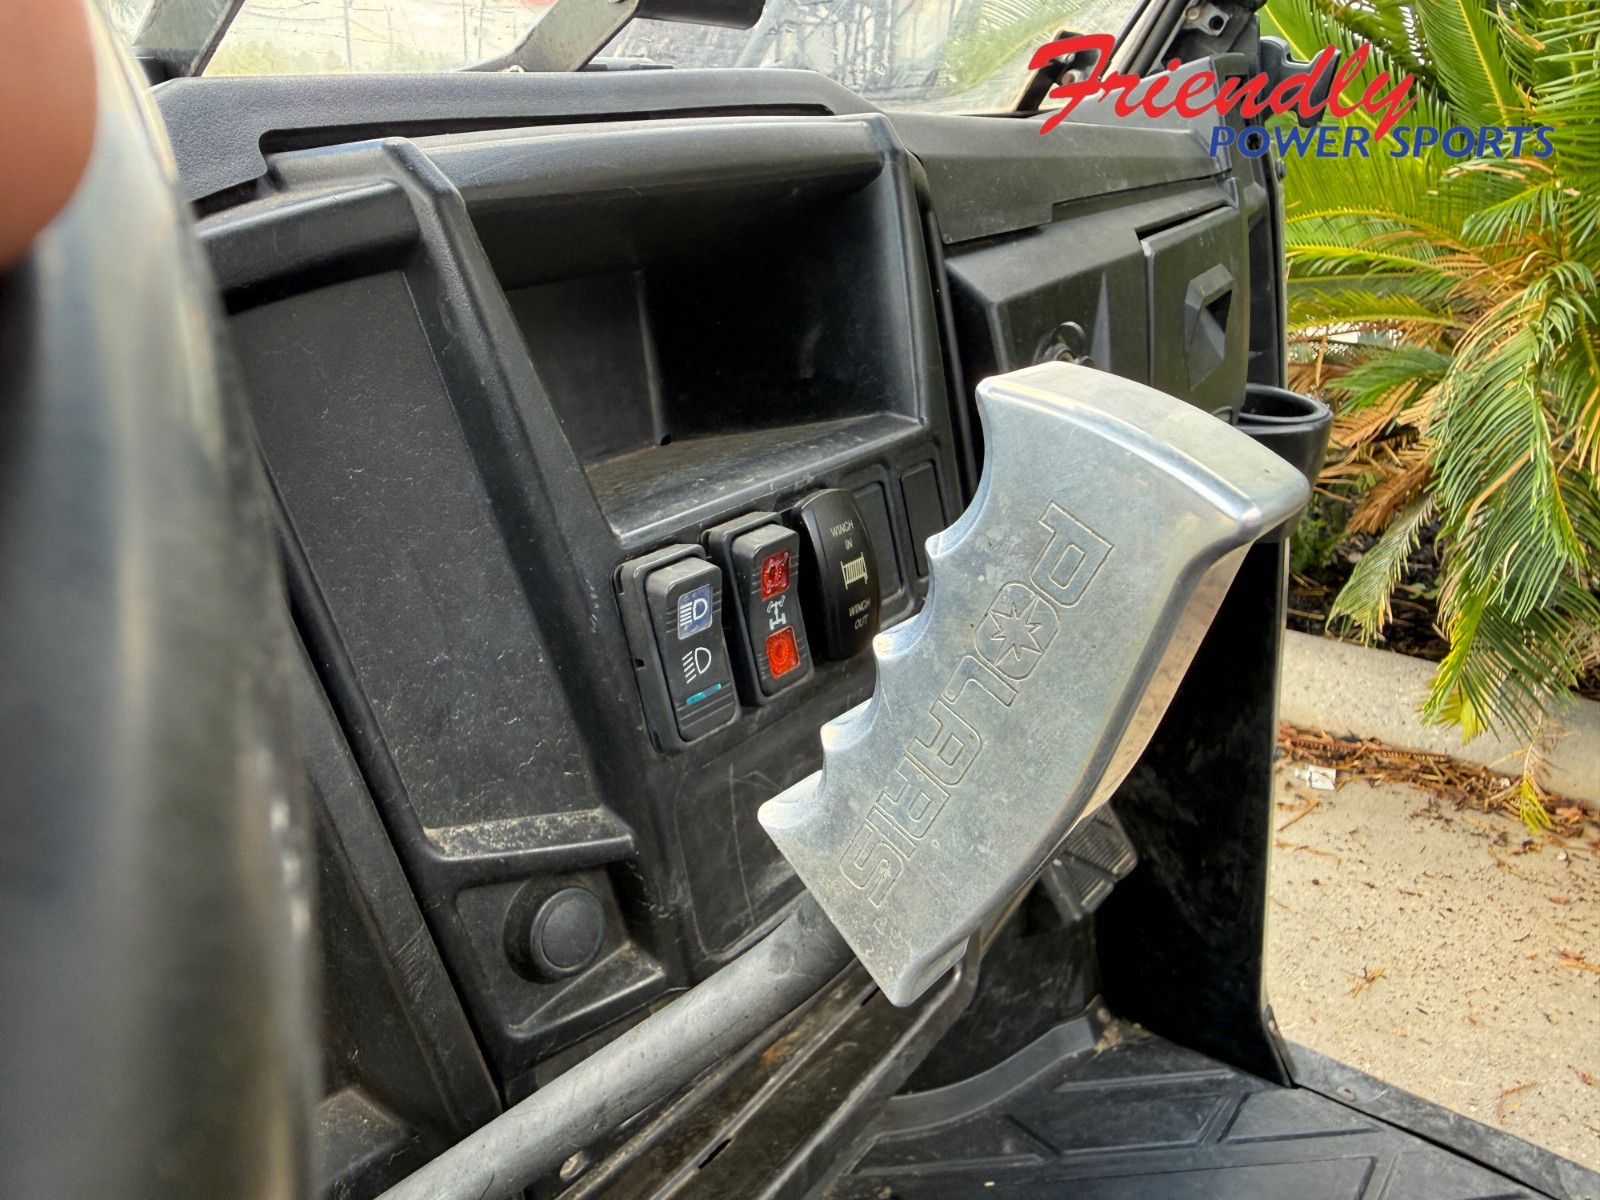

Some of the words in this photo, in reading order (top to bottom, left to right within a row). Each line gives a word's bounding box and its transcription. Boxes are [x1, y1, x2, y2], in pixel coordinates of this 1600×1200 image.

[830, 520, 854, 537] WINCH
[845, 538, 853, 550] IN
[849, 598, 871, 617] WINCH
[854, 614, 869, 630] OUT
[839, 500, 1115, 908] POLARIS
